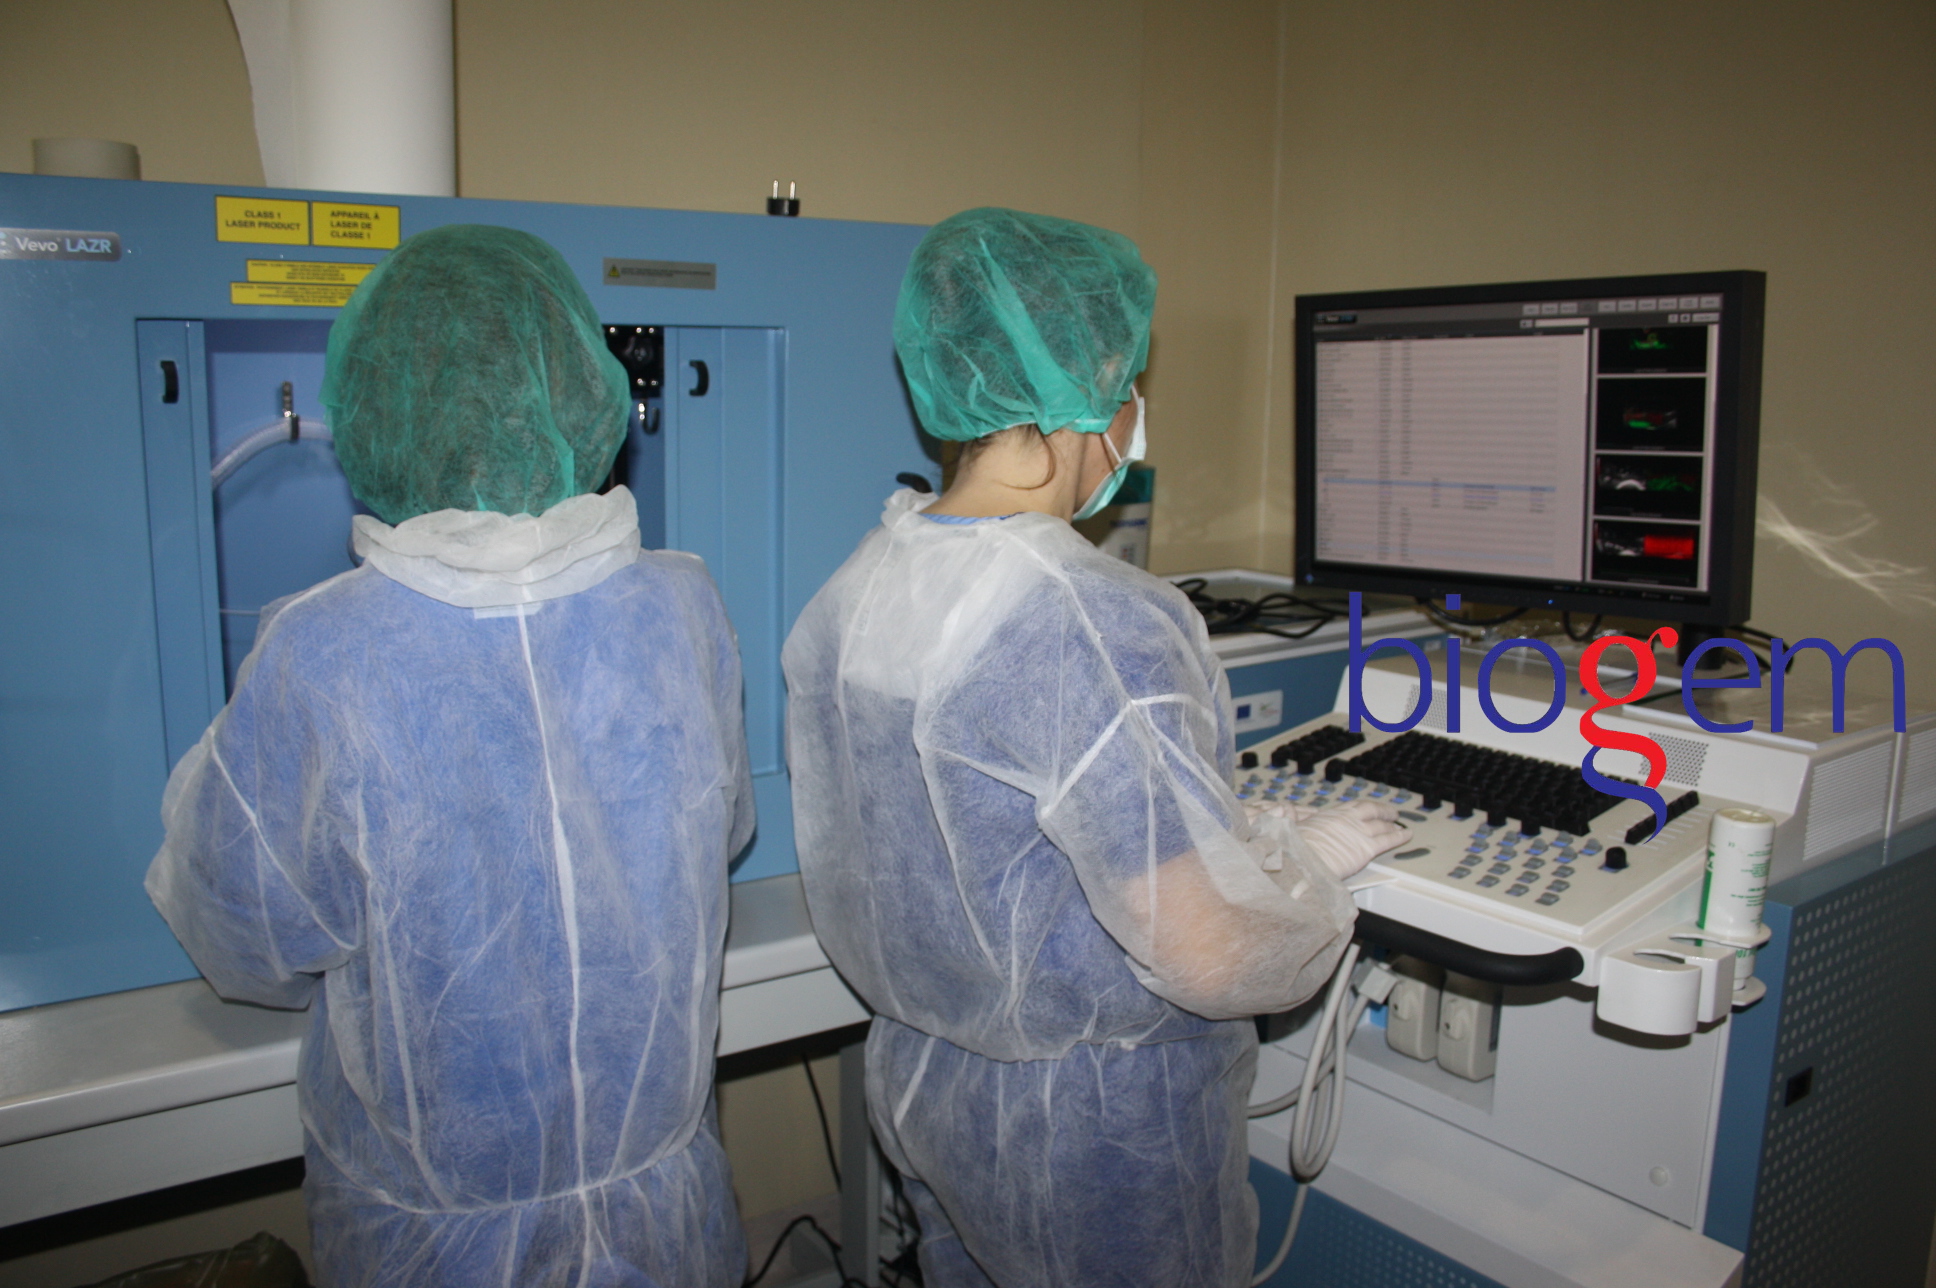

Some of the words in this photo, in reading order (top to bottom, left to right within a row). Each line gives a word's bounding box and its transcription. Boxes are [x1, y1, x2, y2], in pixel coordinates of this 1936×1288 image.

[244, 210, 275, 219] CLASS
[330, 210, 371, 220] APPAREIL
[225, 220, 256, 228] LASER
[258, 221, 301, 231] PRODUCT
[330, 221, 358, 229] LASER
[361, 222, 372, 230] DE
[330, 231, 365, 239] CLASSE
[15, 237, 58, 252] Vevo
[65, 238, 112, 254] LAZR
